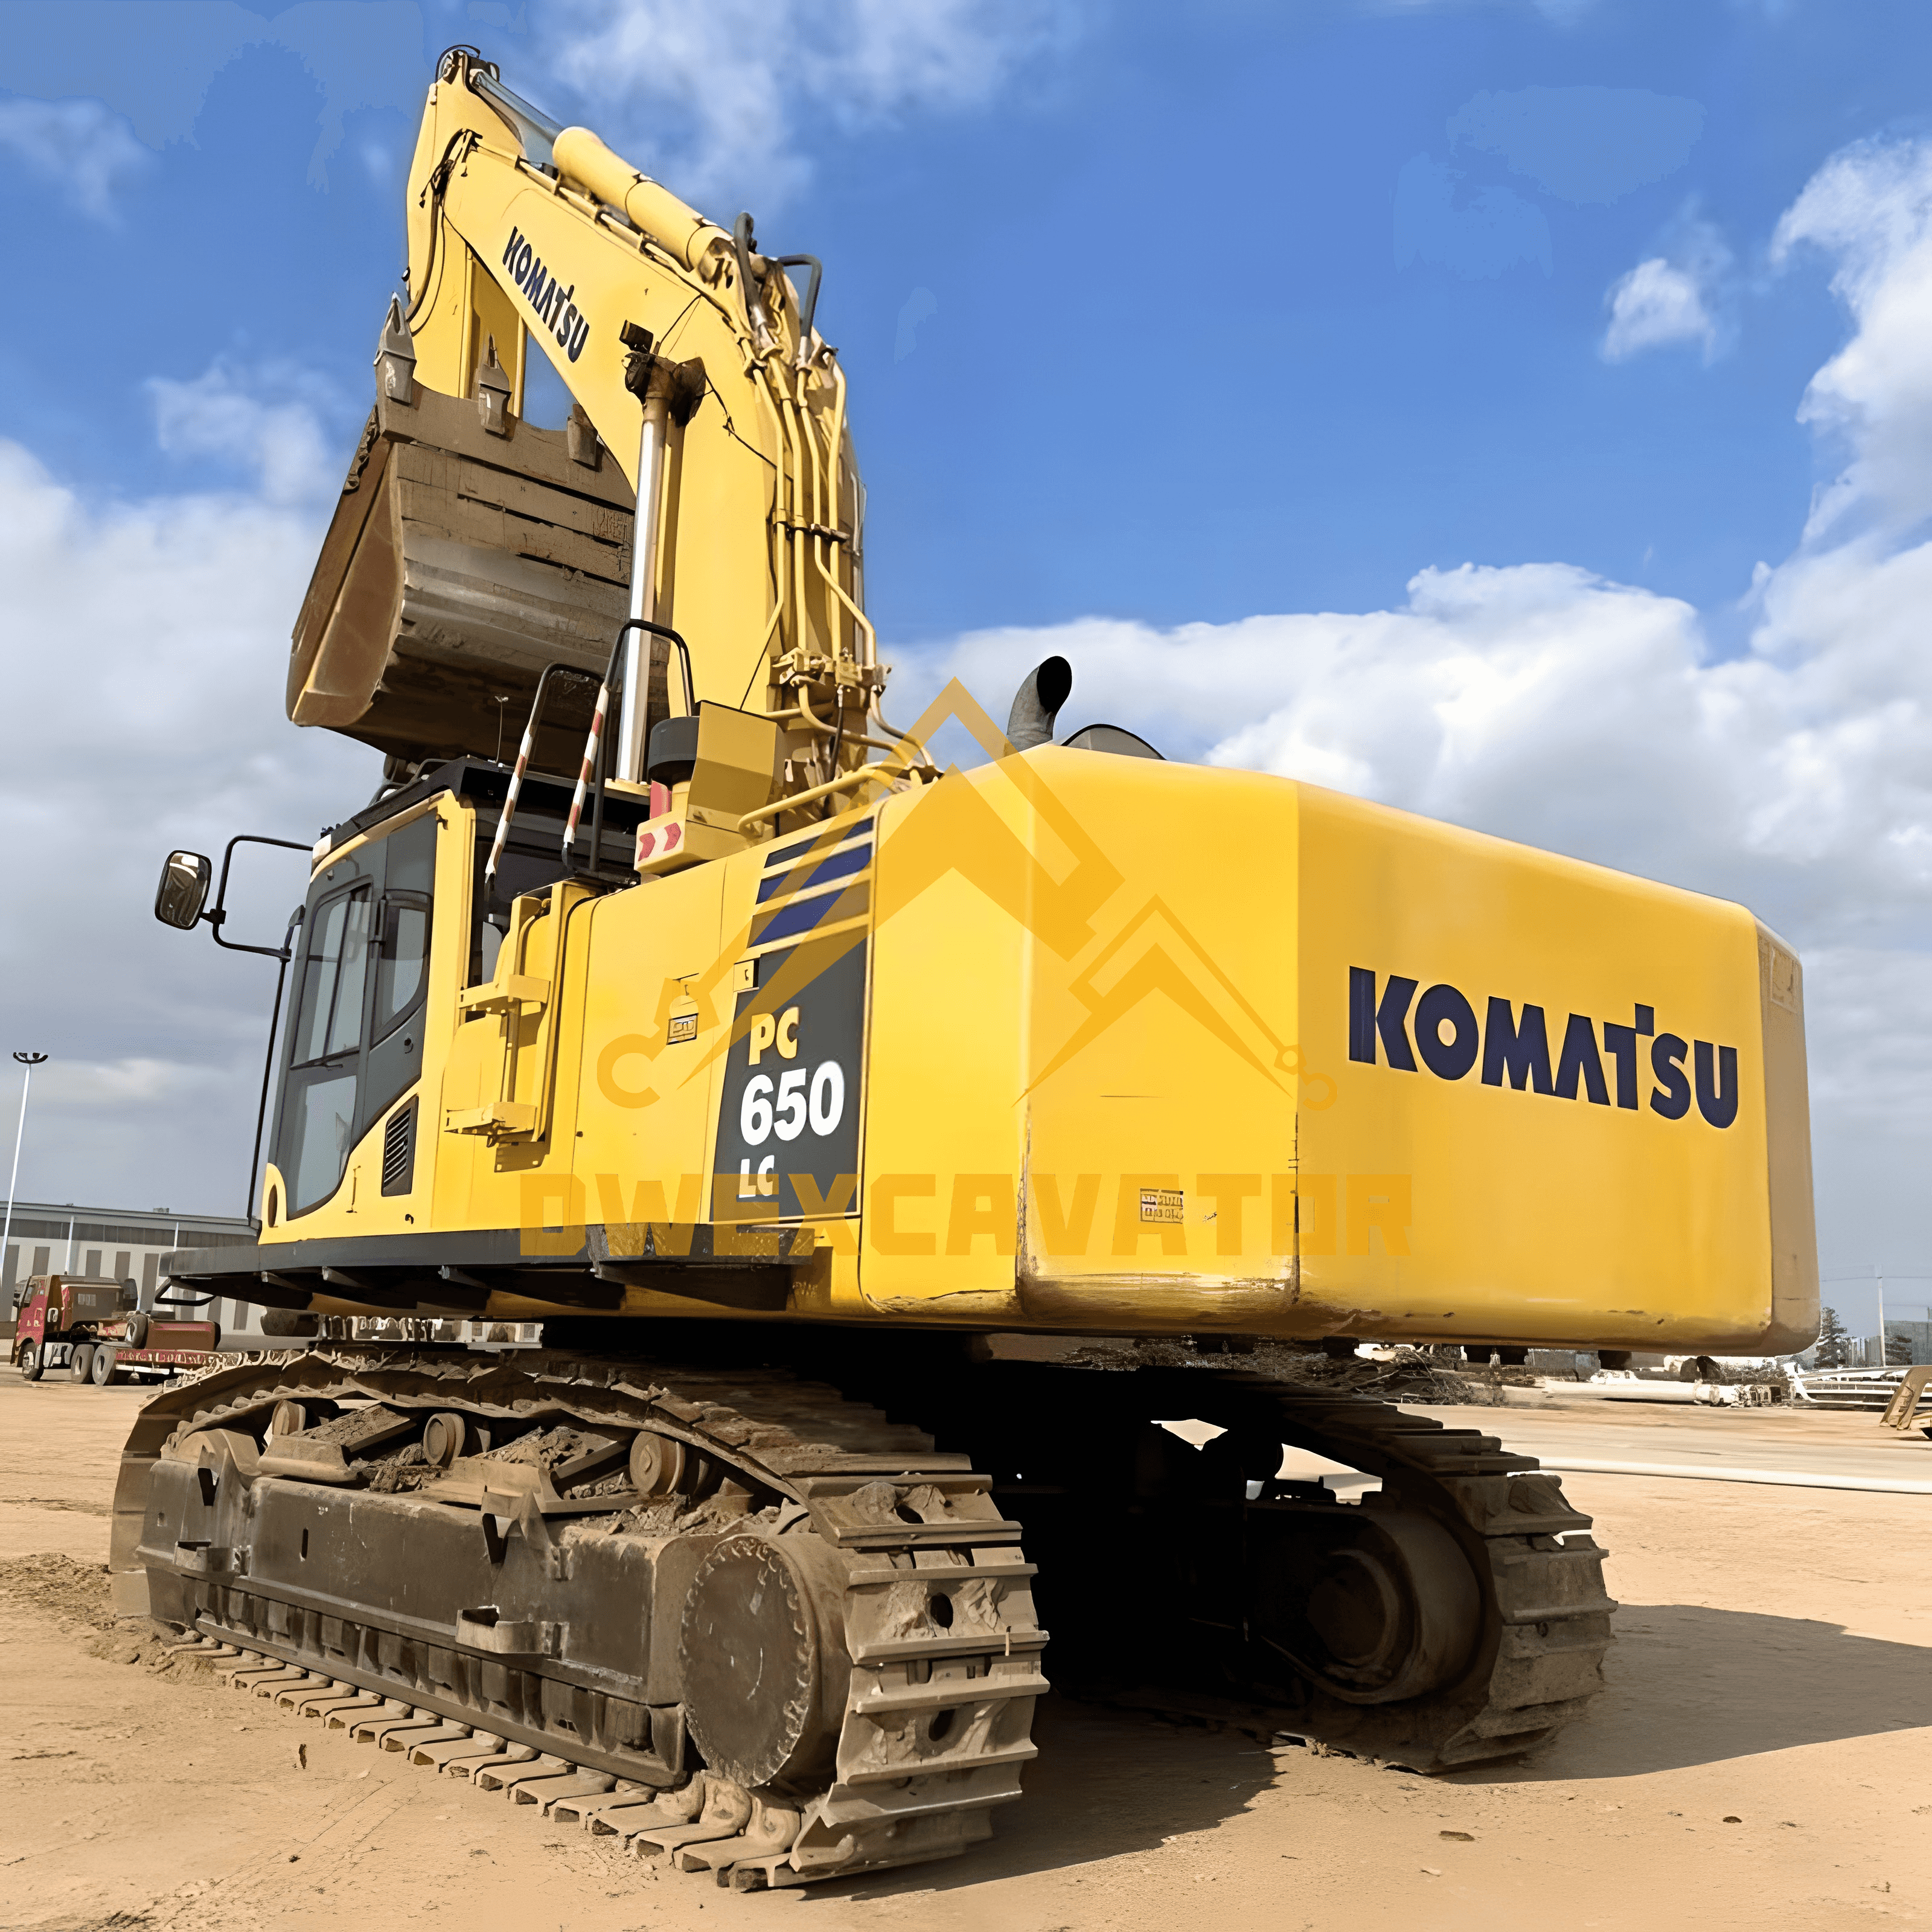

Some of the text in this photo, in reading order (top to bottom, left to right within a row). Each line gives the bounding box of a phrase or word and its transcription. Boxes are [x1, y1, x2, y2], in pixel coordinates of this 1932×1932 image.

[502, 226, 589, 363] KOMATSU
[749, 1006, 799, 1065] PC
[1349, 965, 1738, 1128] KOMATSU
[740, 1061, 844, 1145] 650
[738, 1155, 775, 1198] LC
